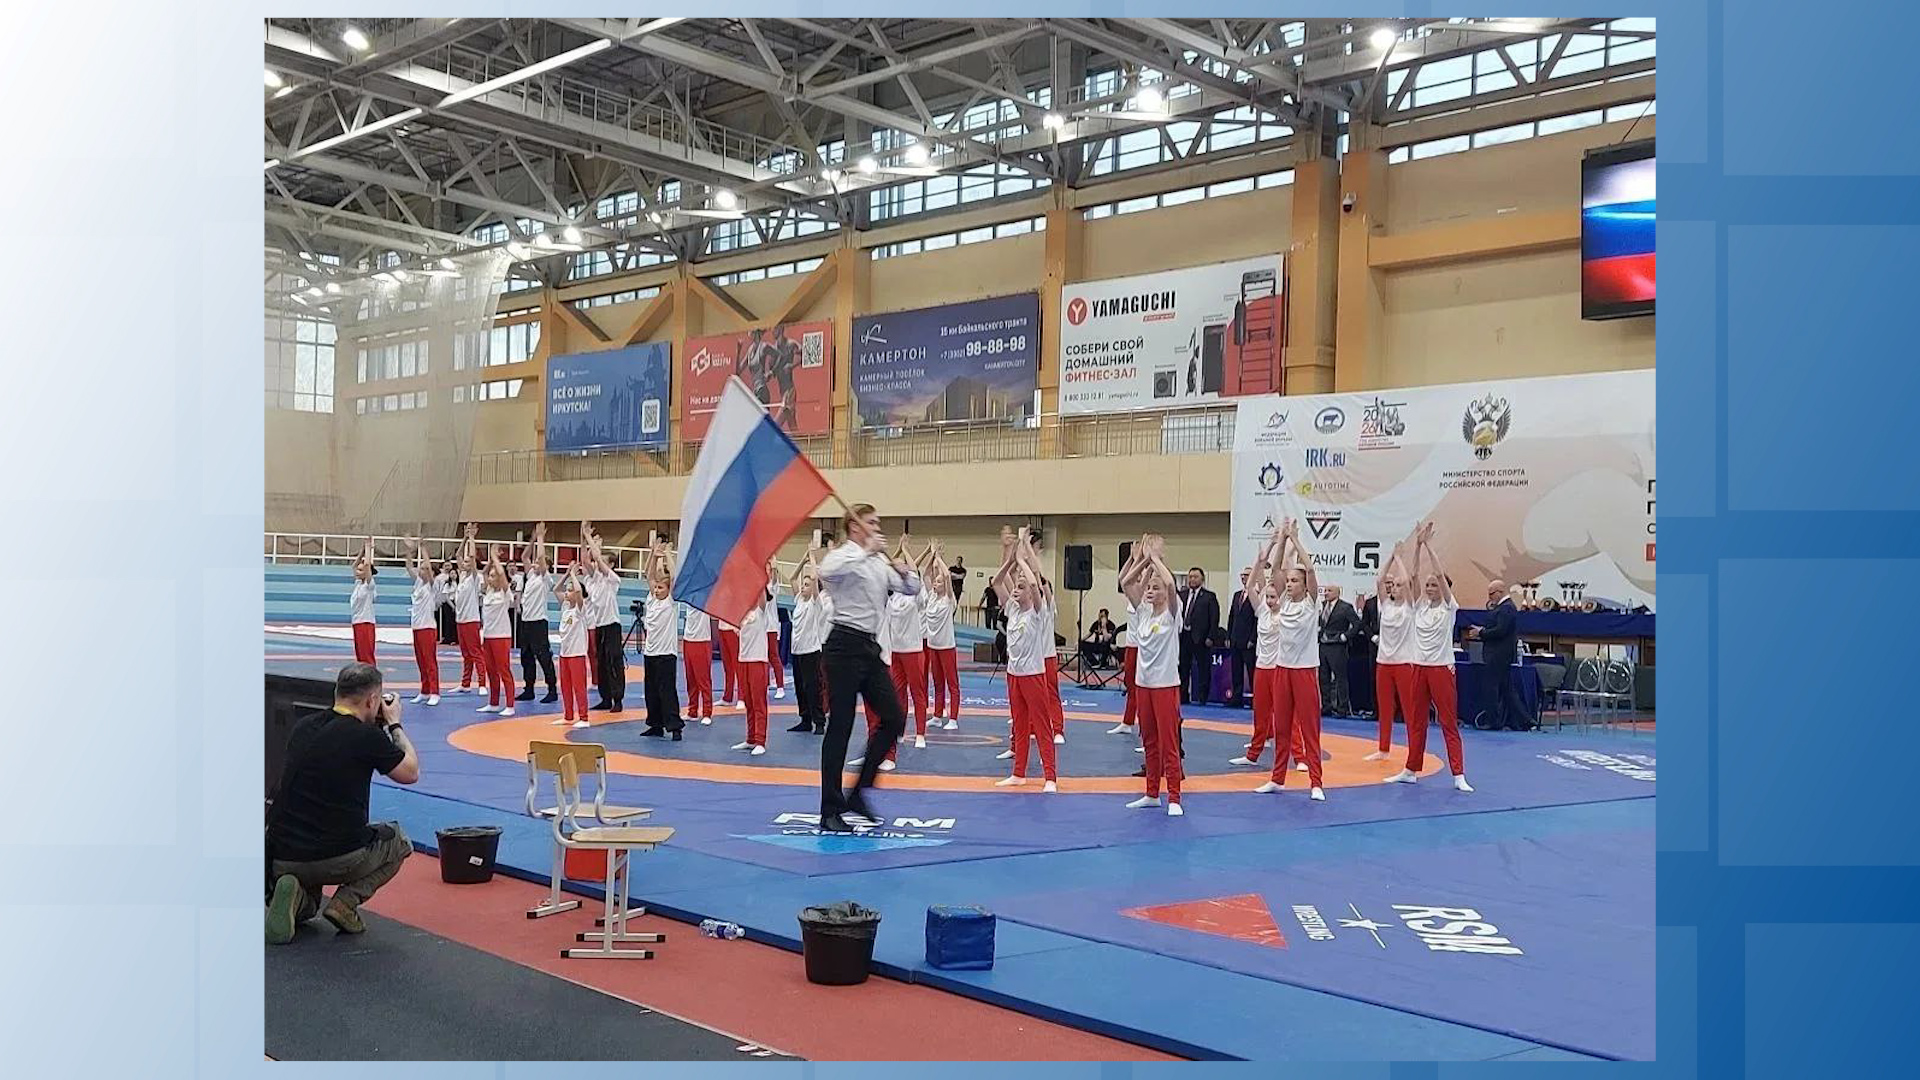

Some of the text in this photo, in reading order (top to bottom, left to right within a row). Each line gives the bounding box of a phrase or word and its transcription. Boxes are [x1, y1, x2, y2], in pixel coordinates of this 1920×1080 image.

[1092, 291, 1176, 318] YAMAGUCHI
[958, 319, 1003, 335] Байкальского
[1004, 317, 1027, 330] тракта
[966, 335, 1026, 357] 98-88-98
[1065, 335, 1144, 355] СОБЕРИ СВОЙ
[860, 346, 926, 366] КАМЕРТОН
[1065, 351, 1134, 371] ДОМАШНИЙ
[860, 370, 894, 382] КАМЕРНЫЙ
[552, 383, 601, 400] ВСЁ О ЖИЗНИ
[860, 380, 912, 392] БИЗНЕС-КЛАССА
[552, 399, 592, 415] ИРКУТСКА!
[1363, 409, 1379, 422] 20
[1361, 422, 1376, 434] 26
[1306, 448, 1346, 468] IRK.RU
[1442, 468, 1525, 478] МИНИСТЕРСТВО СПОРТА
[1314, 482, 1349, 490] AUTOTIME
[1439, 479, 1529, 489] РОССИЙСКОЙ ФЕДЕРАЦИИ
[1211, 654, 1223, 666] 14
[1291, 905, 1336, 941] WRESTLING
[1391, 904, 1525, 955] RSM
